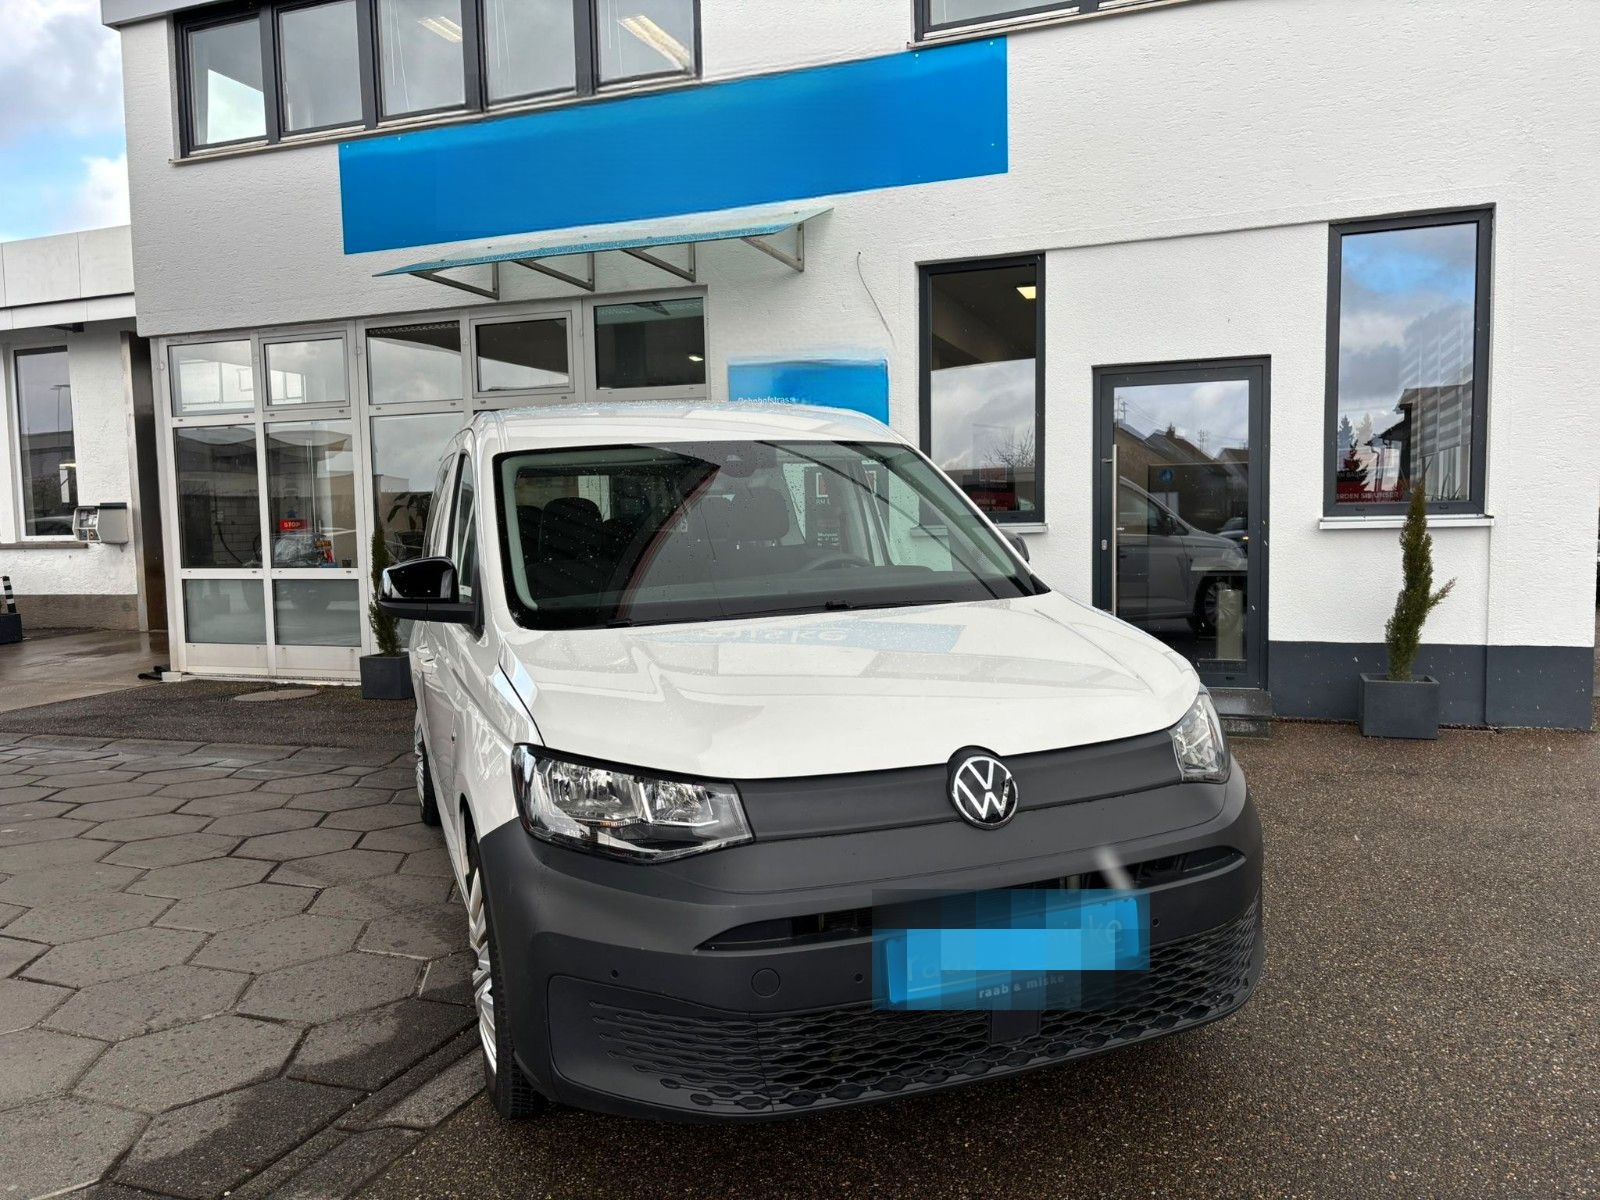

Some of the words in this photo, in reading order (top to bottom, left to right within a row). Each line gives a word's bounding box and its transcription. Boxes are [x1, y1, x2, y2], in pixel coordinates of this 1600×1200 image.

[954, 757, 1015, 823] VW
[979, 983, 1009, 998] raab
[1013, 983, 1022, 992] &
[1026, 974, 1065, 989] miske
